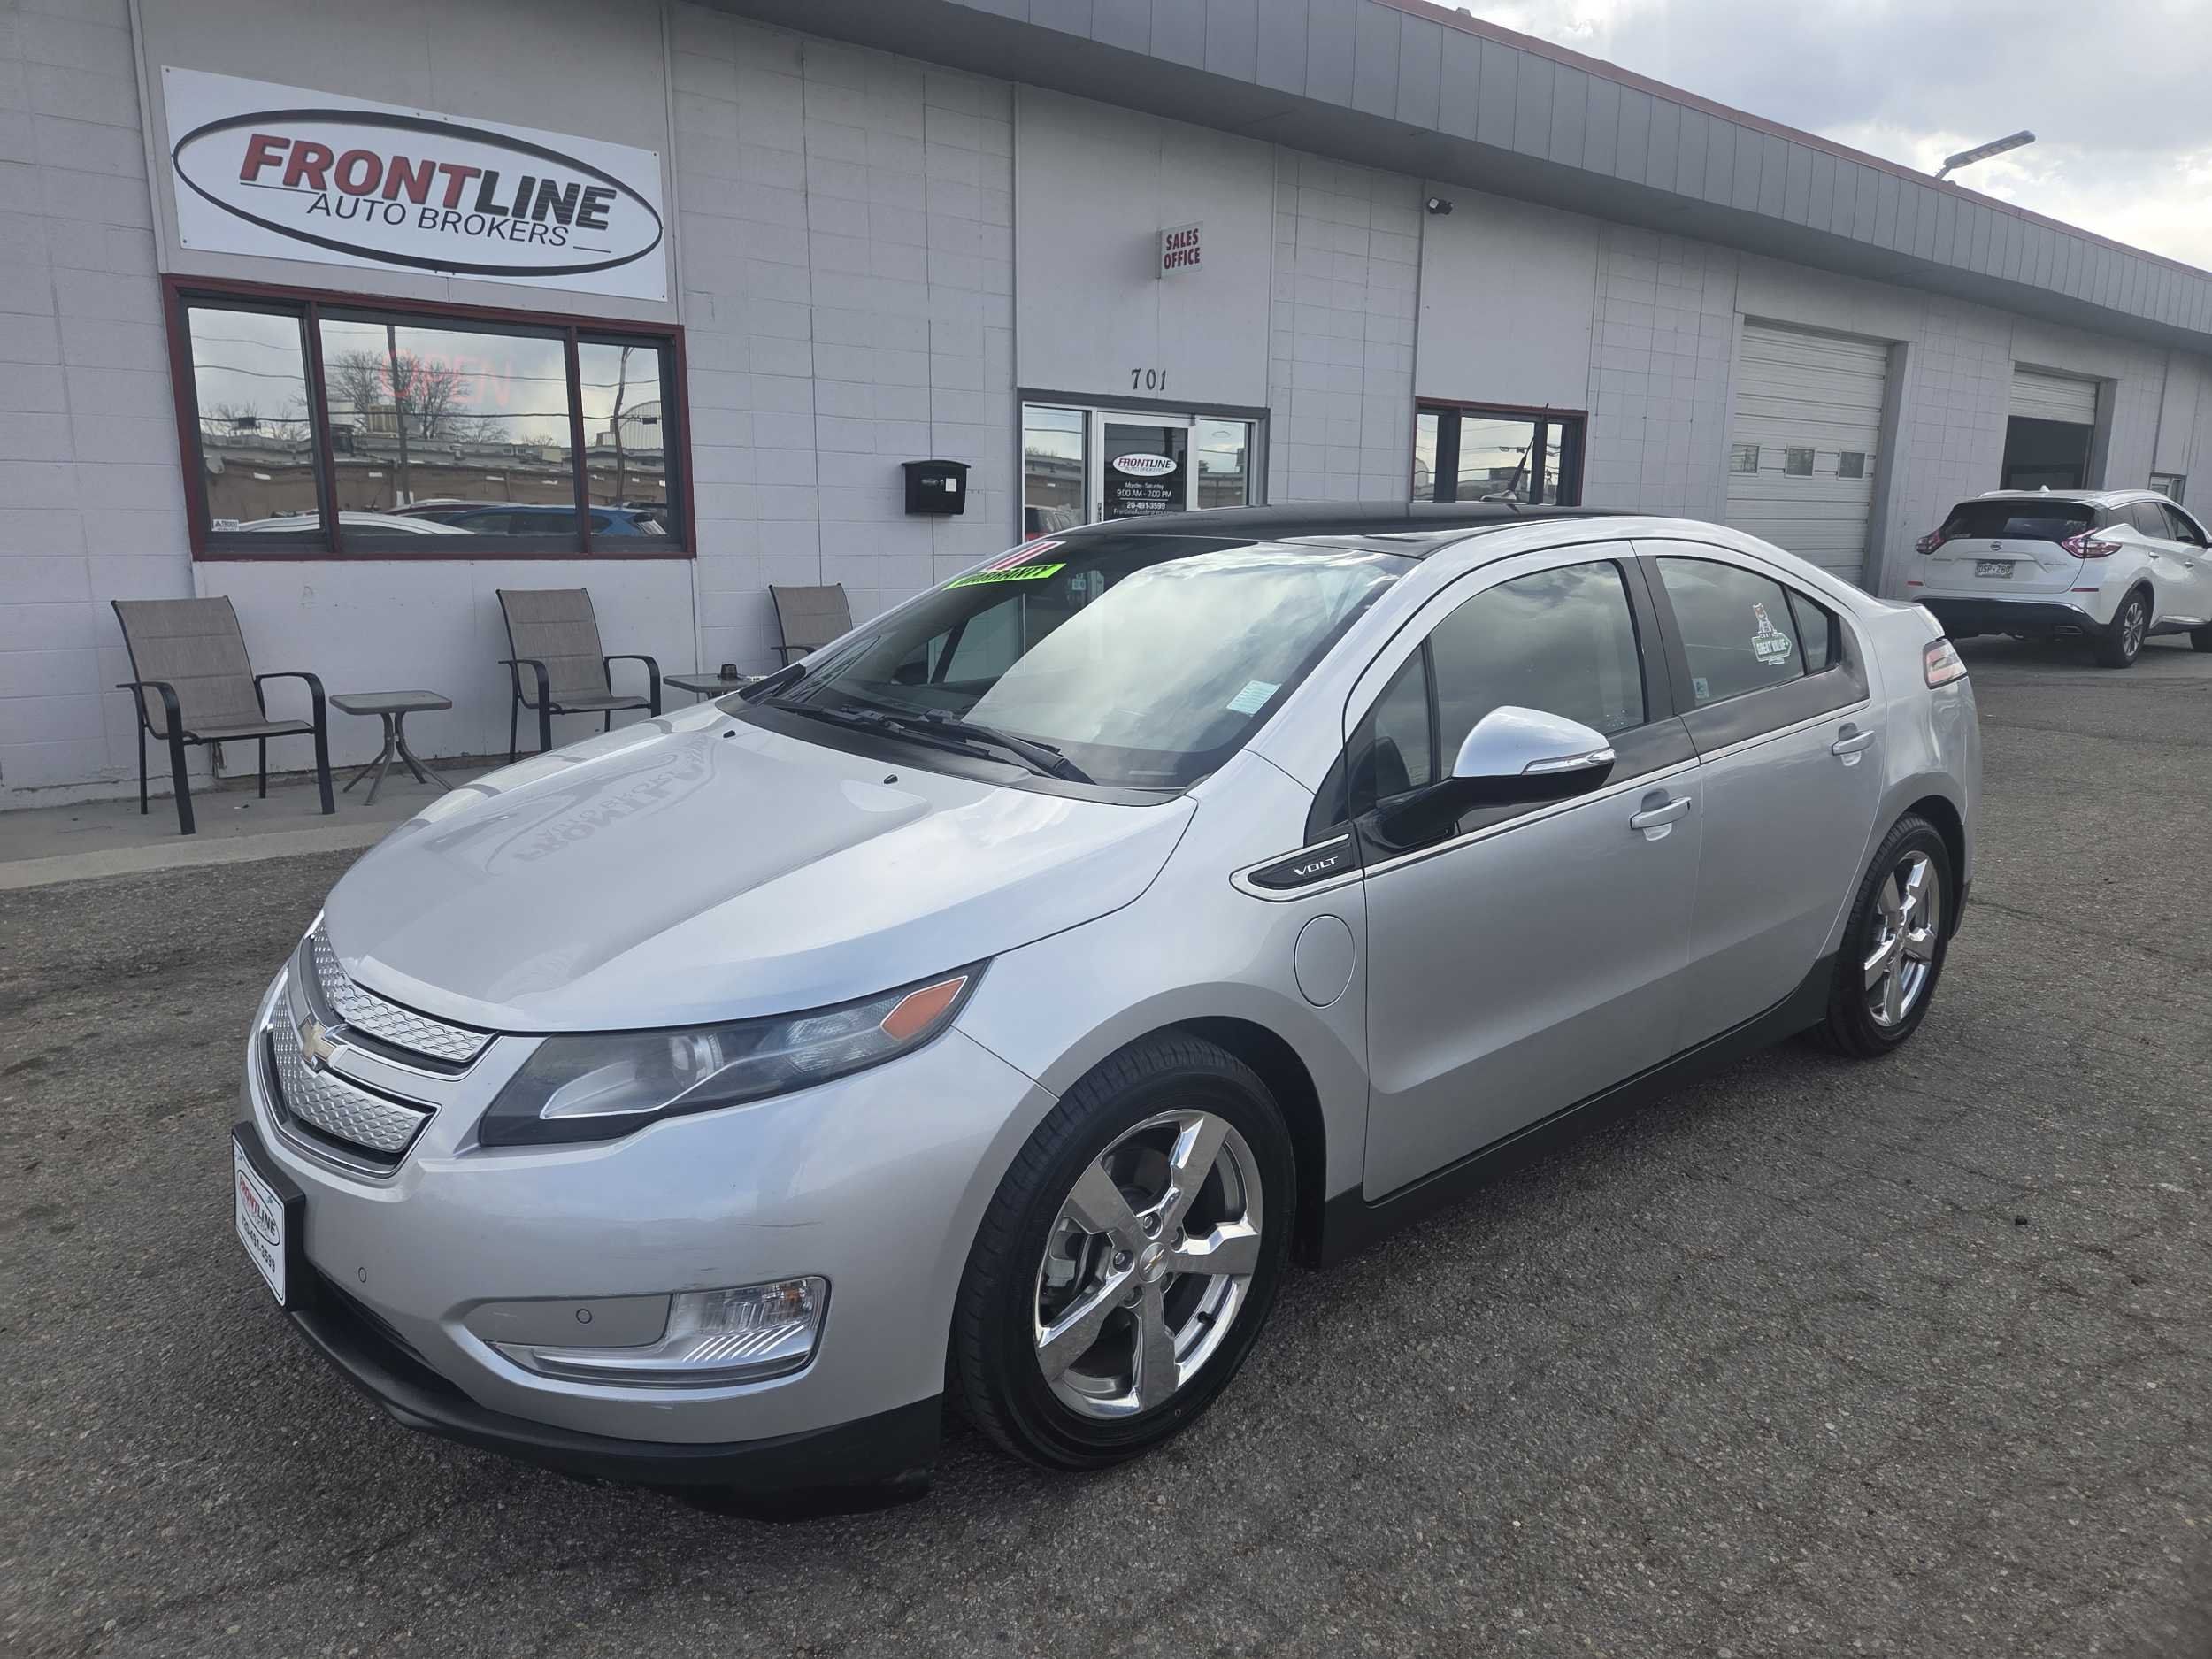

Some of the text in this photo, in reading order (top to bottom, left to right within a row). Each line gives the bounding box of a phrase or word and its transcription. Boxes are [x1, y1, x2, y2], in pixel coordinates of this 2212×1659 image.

[239, 133, 618, 231] FRONTLINE
[306, 193, 570, 247] AUTO BROKERS
[1166, 228, 1198, 250] SALES
[1164, 248, 1200, 269] OFFICE
[1132, 368, 1166, 390] 701
[1118, 457, 1172, 468] FRONTLINE
[1294, 856, 1338, 875] VOLT
